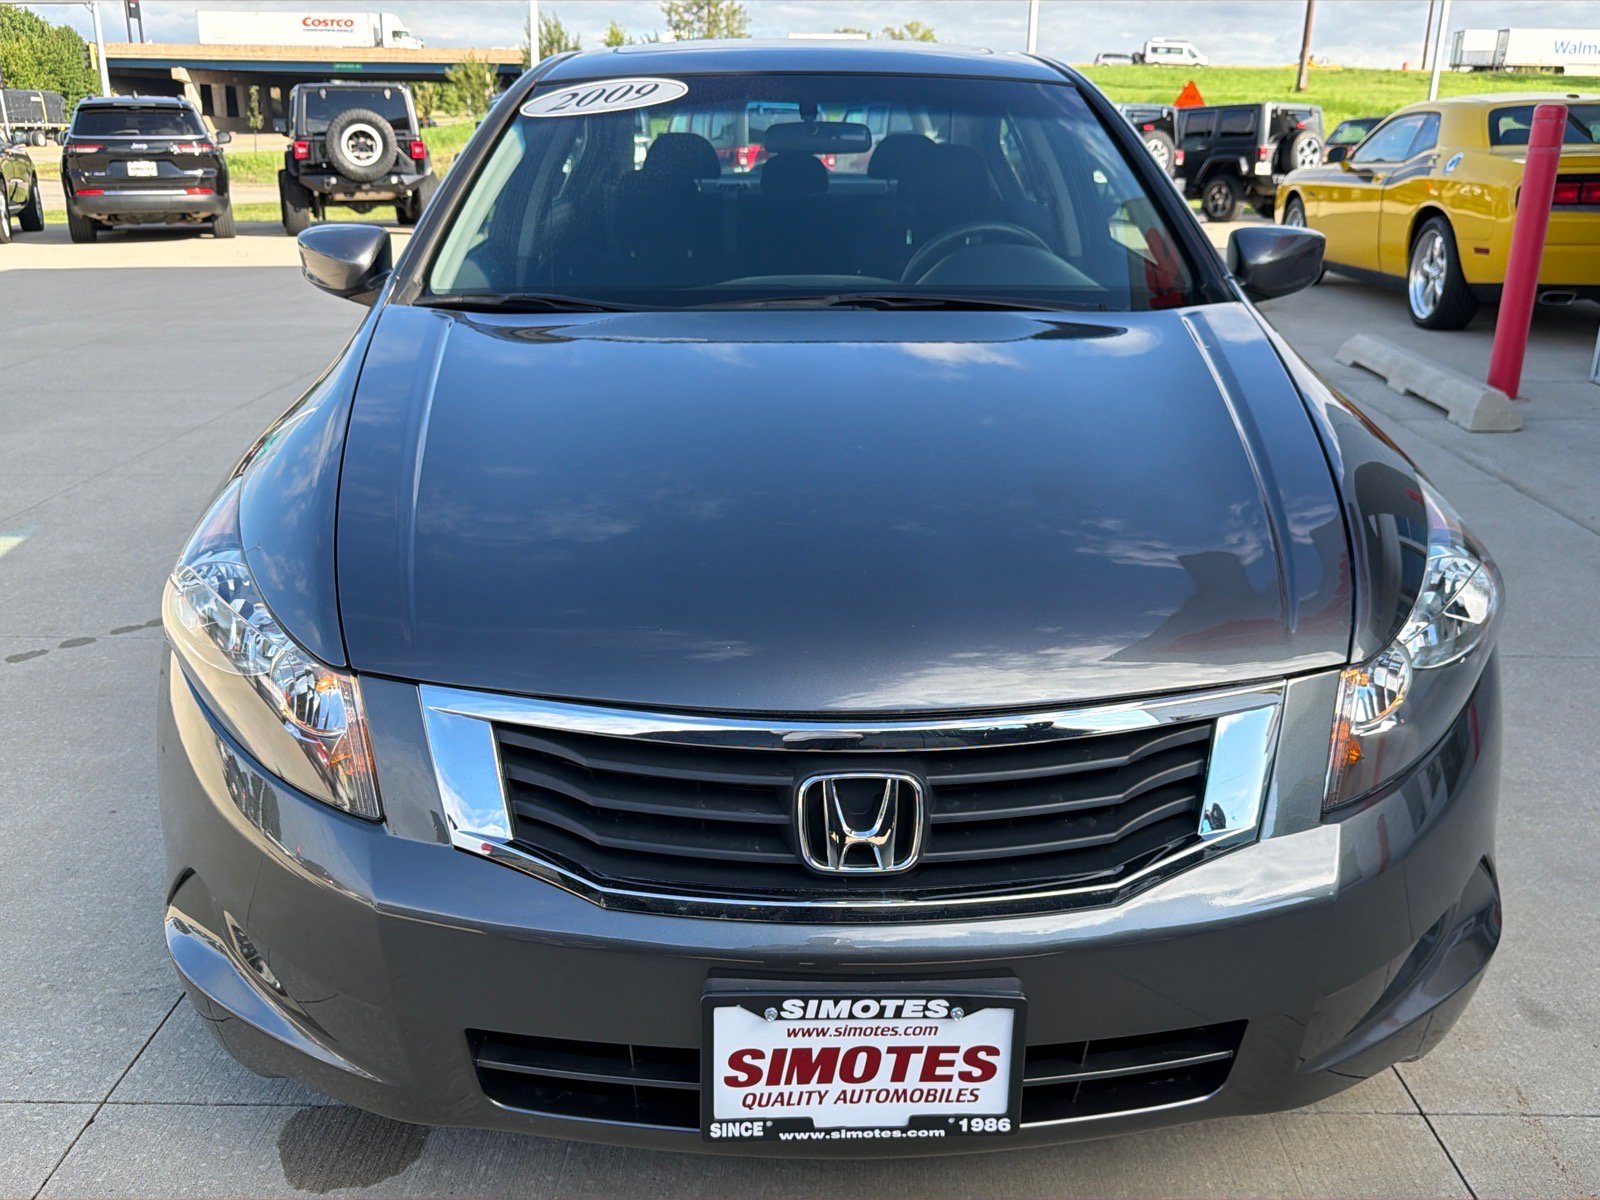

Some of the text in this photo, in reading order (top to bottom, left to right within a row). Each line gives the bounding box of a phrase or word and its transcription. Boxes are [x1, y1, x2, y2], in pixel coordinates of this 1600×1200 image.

[302, 16, 354, 28] COSTCO
[1554, 40, 1600, 55] Walm
[545, 83, 660, 113] 2009
[779, 998, 951, 1020] SIMOTES
[786, 1024, 939, 1039] www.simotes.com
[723, 1045, 1001, 1088] SIMOTES
[741, 1087, 981, 1110] QUALITY AUTOMOBILES
[709, 1117, 1012, 1138] SINCE 1986
[778, 1128, 946, 1141] www.simotes.com
